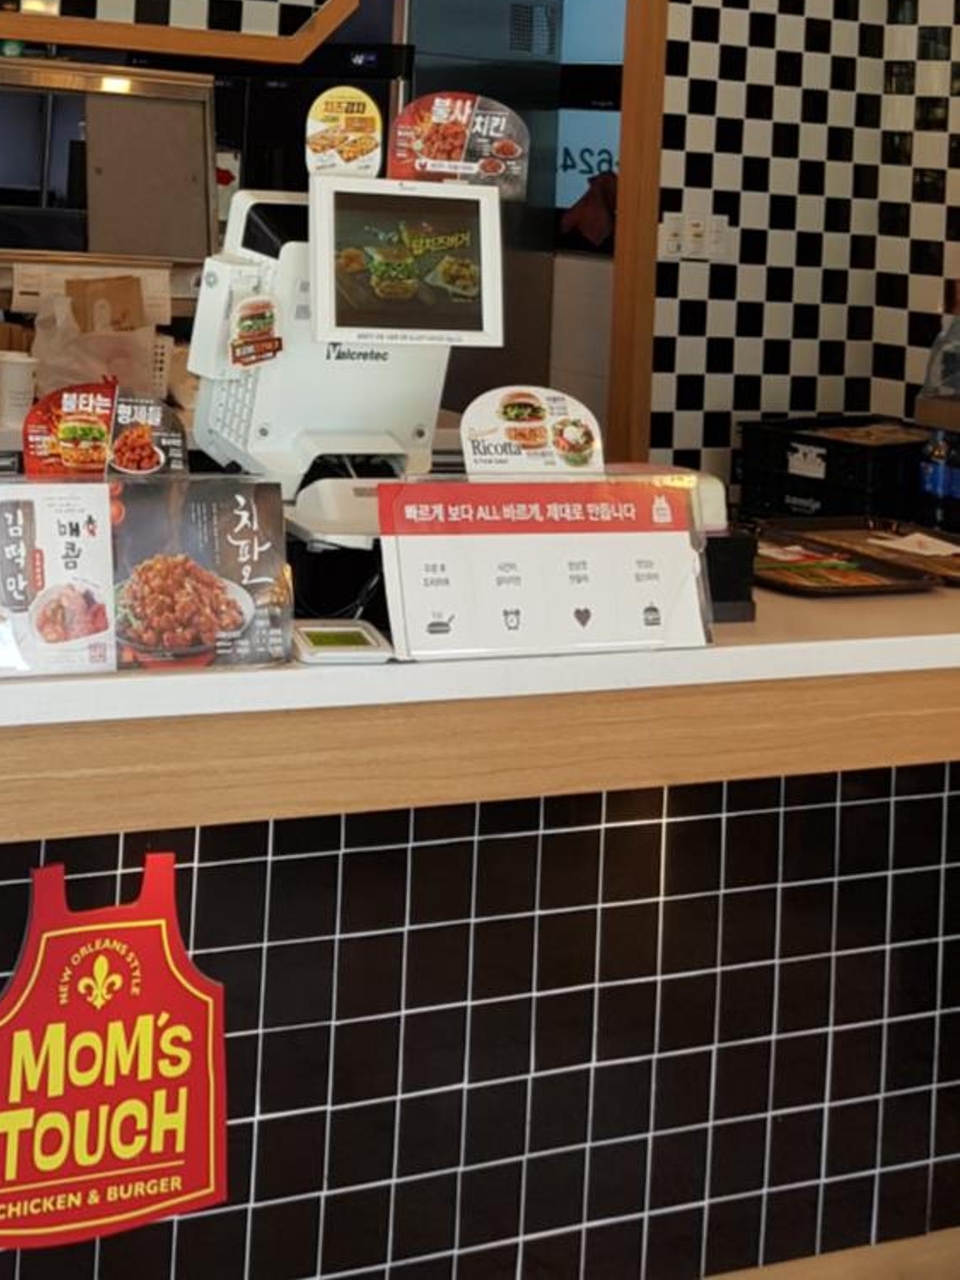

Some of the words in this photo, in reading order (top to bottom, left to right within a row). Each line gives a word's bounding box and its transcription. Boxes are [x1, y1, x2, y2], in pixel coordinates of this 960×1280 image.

[471, 113, 507, 137] 치킨
[471, 438, 523, 457] Ricotta
[476, 505, 501, 521] ALL
[57, 519, 82, 570] 매콤
[59, 965, 73, 1006] NEW
[70, 938, 130, 967] ORLEANS
[123, 950, 145, 998] STYLE
[86, 1189, 100, 1206] &
[106, 1174, 183, 1202] BURGER
